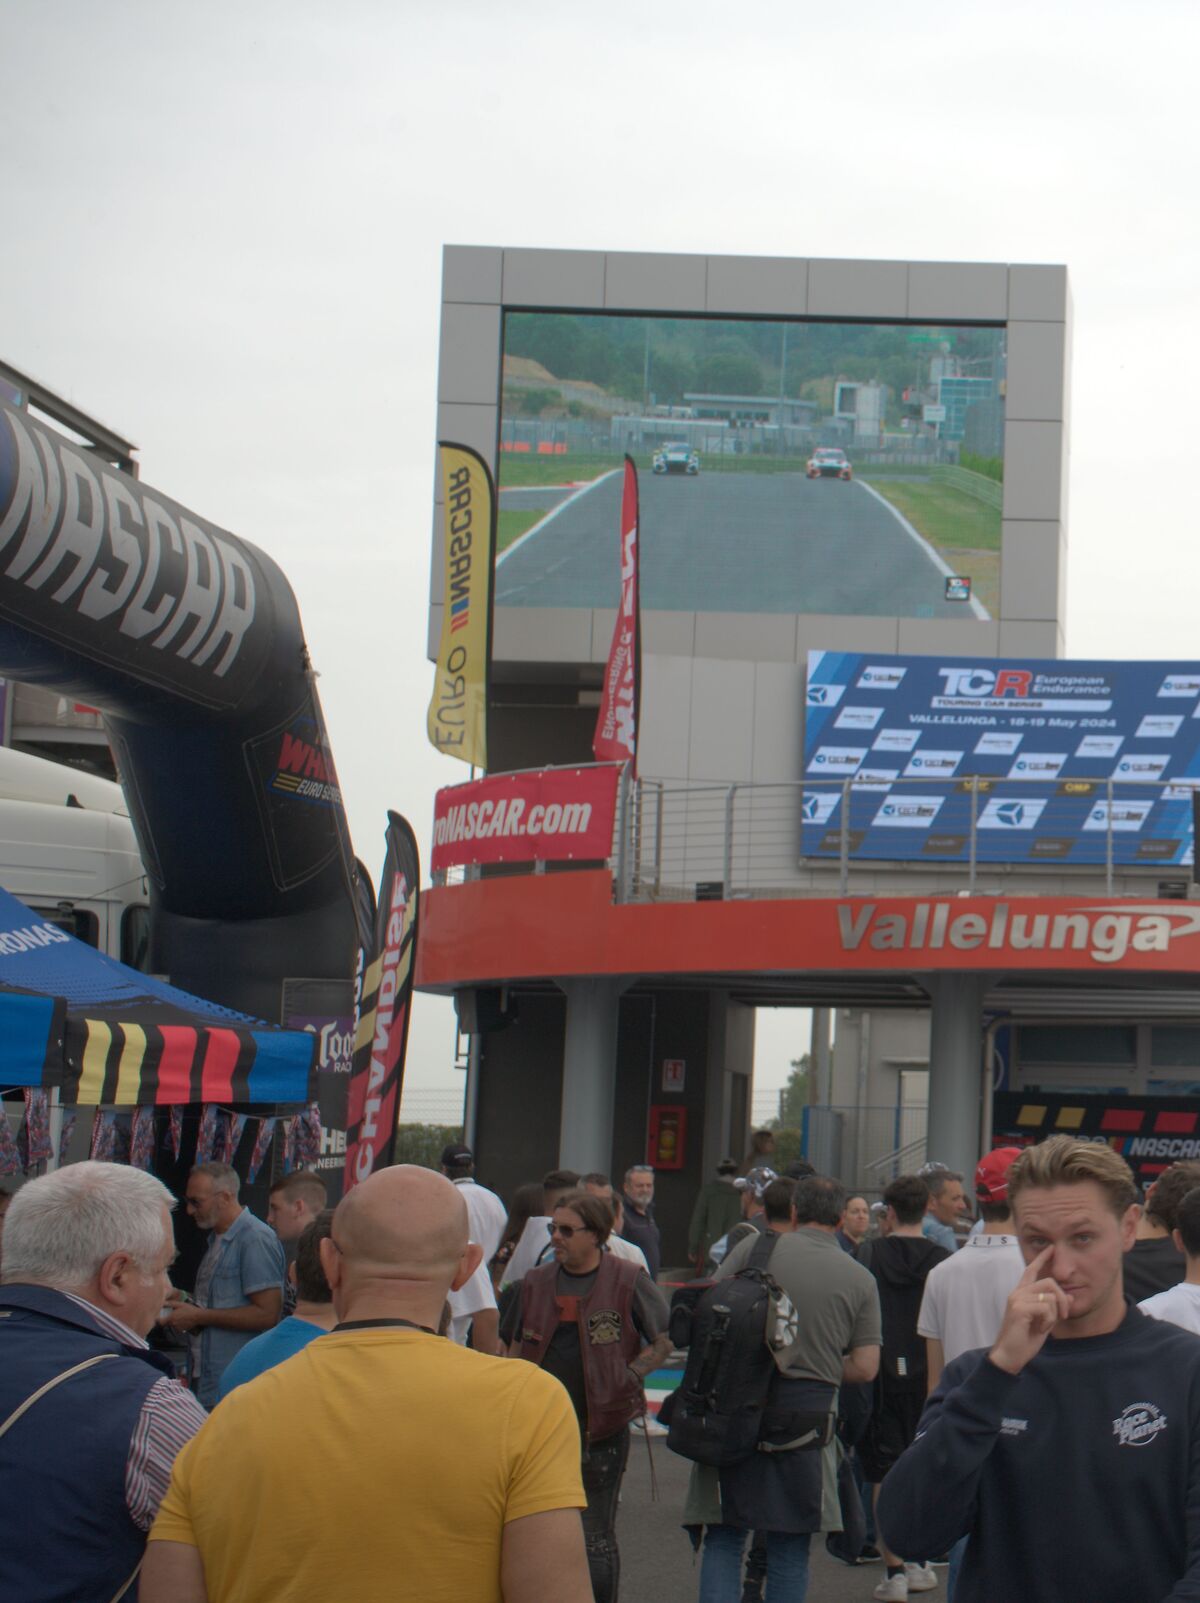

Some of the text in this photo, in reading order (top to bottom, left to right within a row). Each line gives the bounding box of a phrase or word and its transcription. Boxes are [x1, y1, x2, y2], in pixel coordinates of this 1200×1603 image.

[0, 407, 256, 678] NASCAR
[938, 667, 1033, 698] TCR
[1035, 675, 1105, 686] European
[1033, 685, 1111, 695] Endurance
[984, 700, 1004, 708] CAR
[909, 714, 997, 725] VALLELUNGA
[1048, 718, 1077, 729] May
[1080, 719, 1117, 728] 2024
[296, 779, 322, 798] EURO
[836, 903, 1173, 963] Vallelunga
